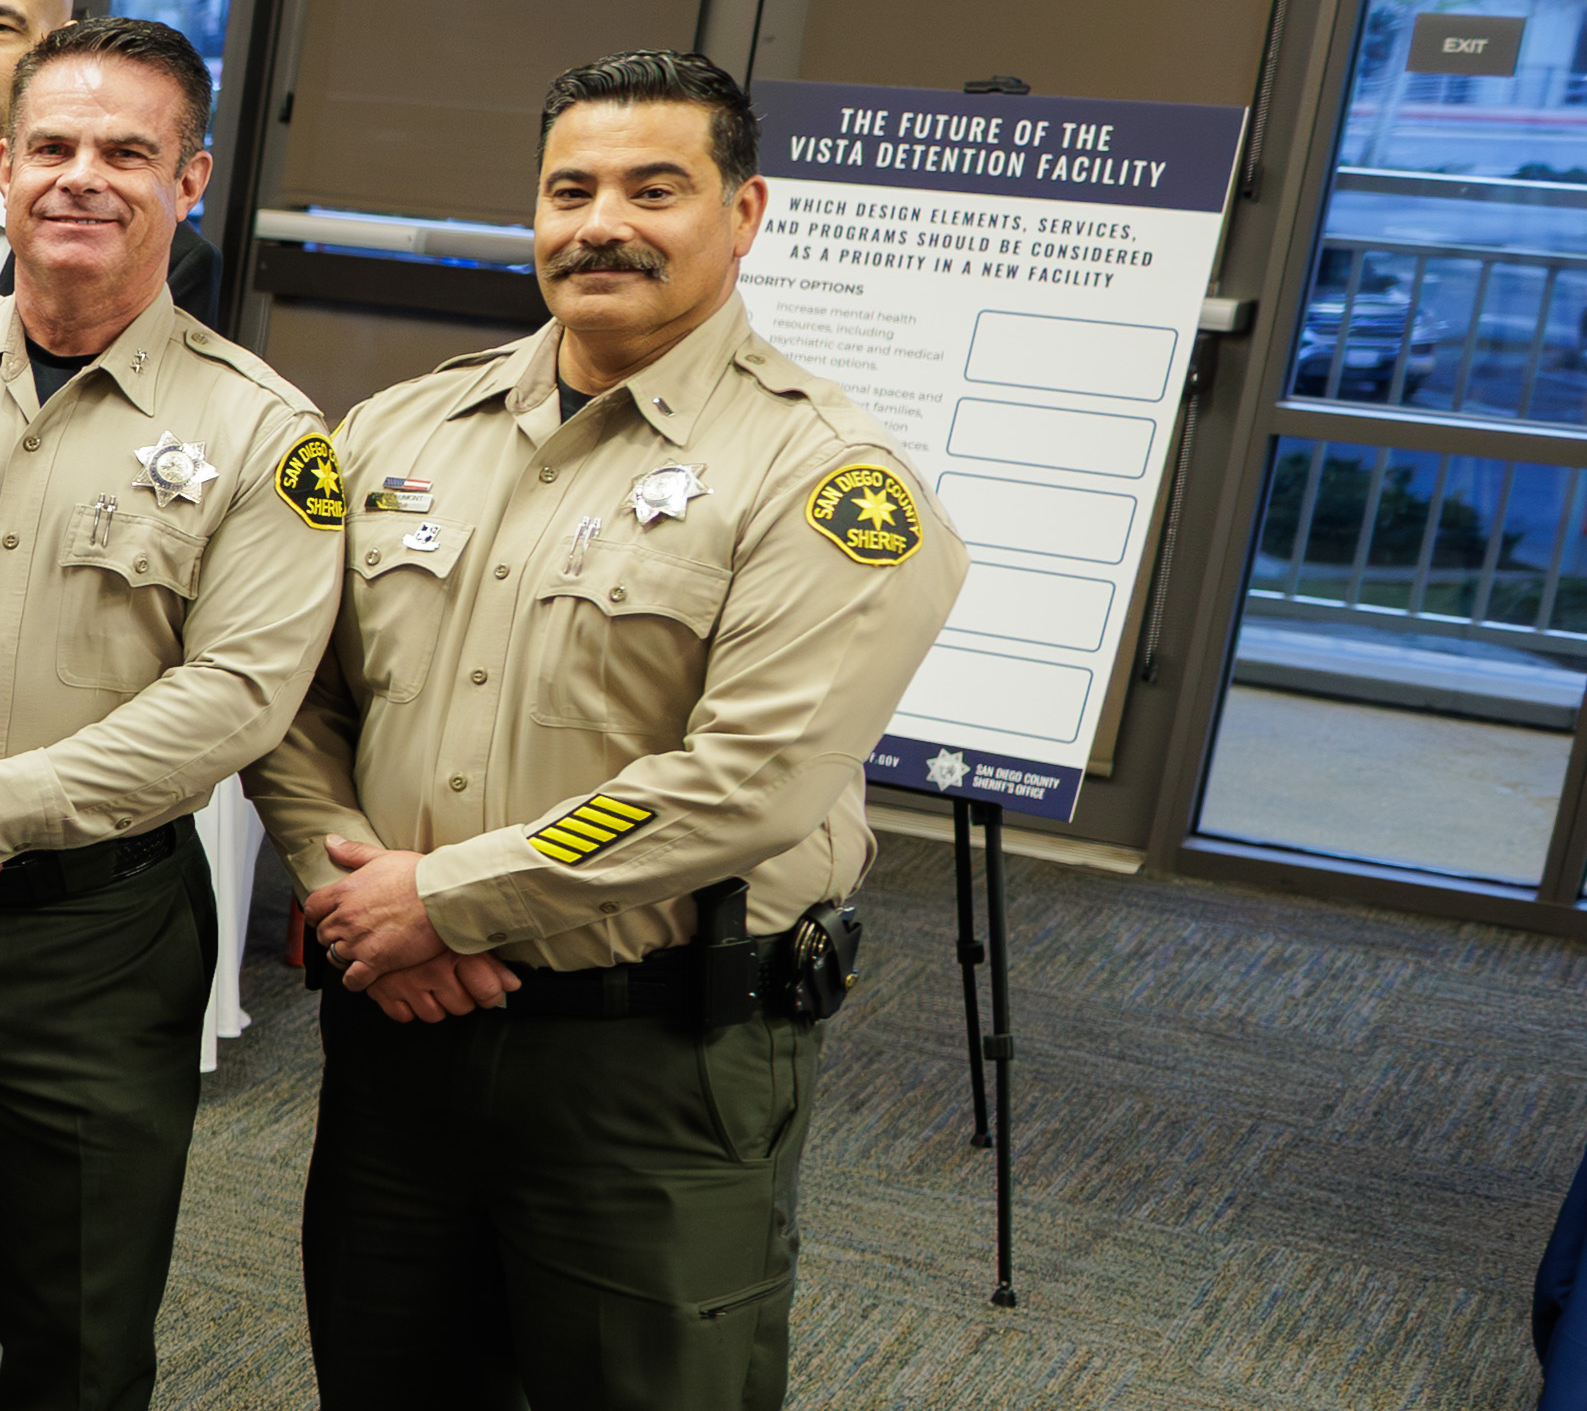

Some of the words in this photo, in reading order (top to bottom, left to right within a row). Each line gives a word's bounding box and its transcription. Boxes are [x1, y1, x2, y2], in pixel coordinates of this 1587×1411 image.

[1443, 37, 1488, 54] EXIT
[840, 108, 889, 137] THE
[898, 112, 1003, 144] FUTURE
[1013, 119, 1050, 147] OF
[1061, 122, 1115, 152] THE
[789, 136, 864, 167] VISTA
[875, 142, 1026, 179] DETENTION
[1036, 154, 1167, 188] FACILITY
[789, 197, 847, 216] WHICH
[855, 202, 922, 222] DESIGN
[930, 208, 1028, 234] ELEMENTS,
[1037, 217, 1138, 243] SERVICES,
[764, 218, 799, 235] AND
[808, 222, 908, 246] PROGRAMS
[917, 231, 990, 253] SHOULD
[1000, 238, 1022, 256] BE
[1030, 241, 1154, 268] CONSIDERED
[790, 245, 811, 261] AS
[819, 247, 830, 263] A
[838, 249, 927, 272] PRIORITY
[934, 258, 953, 274] IN
[961, 260, 972, 276] A
[981, 262, 1020, 280] NEW
[1028, 266, 1116, 290] FACILITY
[739, 273, 796, 289] RIORITY
[800, 278, 865, 296] OPTIONS
[776, 301, 828, 316] Increase
[830, 306, 875, 321] mental
[877, 310, 917, 325] health
[773, 318, 834, 334] resources,
[836, 324, 895, 341] including
[769, 333, 834, 351] psychiatric
[837, 340, 864, 352] care
[866, 342, 891, 356] and
[893, 346, 944, 361] medical
[829, 355, 879, 371] options.
[873, 388, 916, 402] spaces
[918, 391, 944, 404] and
[873, 401, 924, 419] families,
[283, 456, 305, 489] SAN
[298, 441, 328, 463] DIEGO
[306, 497, 342, 518] SHERIF
[814, 486, 844, 520] SAN
[834, 470, 883, 493] DIEGO
[885, 478, 921, 536] COUNTY
[846, 528, 907, 554] SHERIFF
[972, 776, 1015, 795] SHERIFF'S
[1015, 783, 1045, 800] OFFICE
[975, 763, 994, 778] SAN
[995, 767, 1023, 783] DIEGO
[1024, 771, 1060, 790] COUNTY
